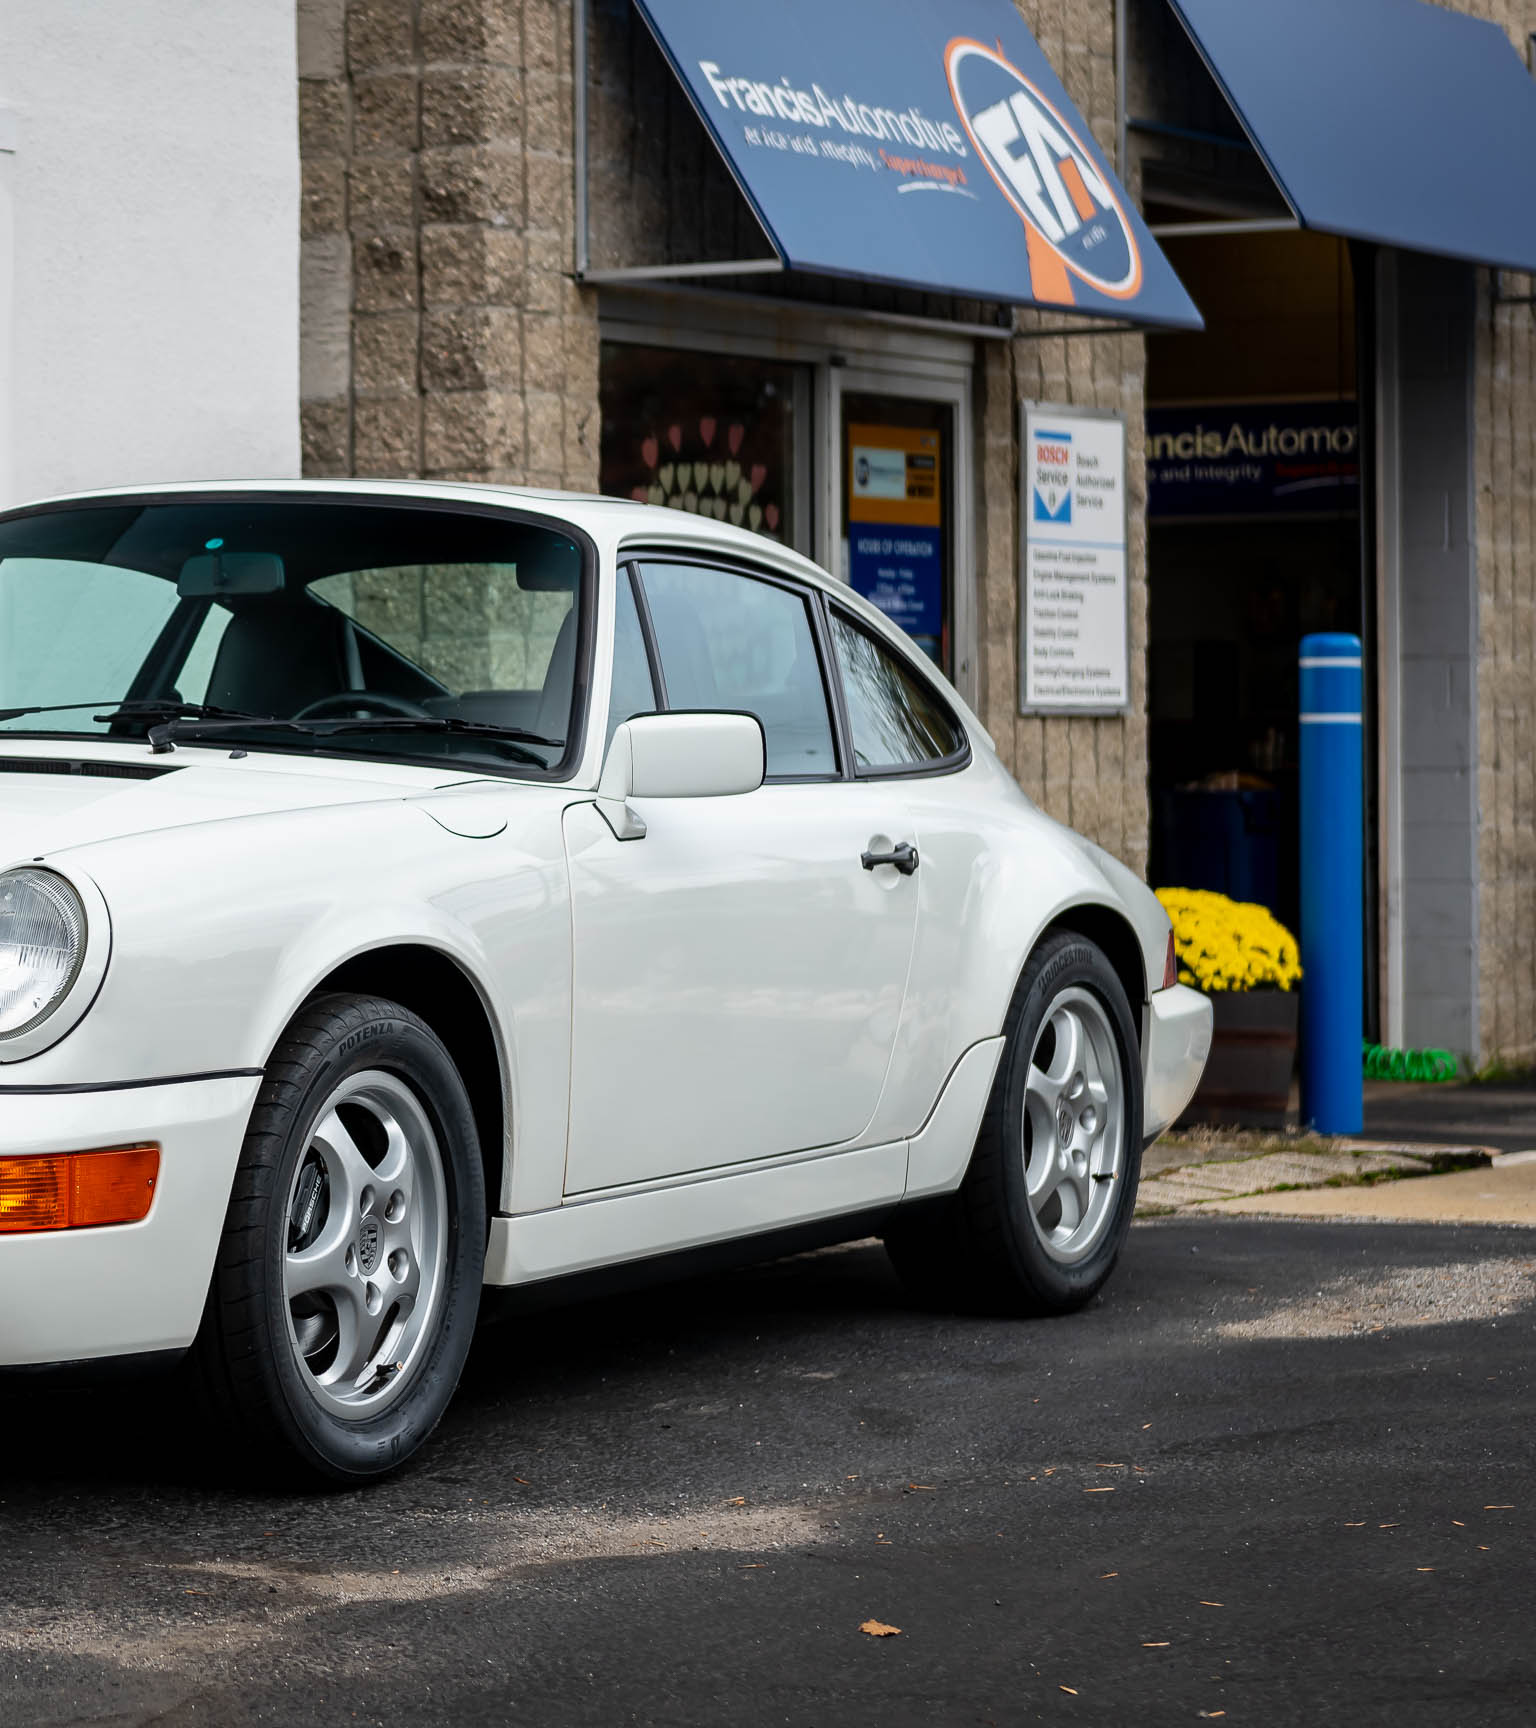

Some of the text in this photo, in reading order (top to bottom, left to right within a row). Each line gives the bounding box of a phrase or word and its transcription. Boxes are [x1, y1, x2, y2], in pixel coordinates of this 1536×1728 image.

[699, 61, 967, 158] FrancisAutomotive
[1036, 444, 1069, 465] BOSCH
[1145, 422, 1357, 460] ncisAutomo
[1036, 468, 1069, 487] Service
[1160, 464, 1191, 482] and
[339, 1022, 394, 1056] POTENZA
